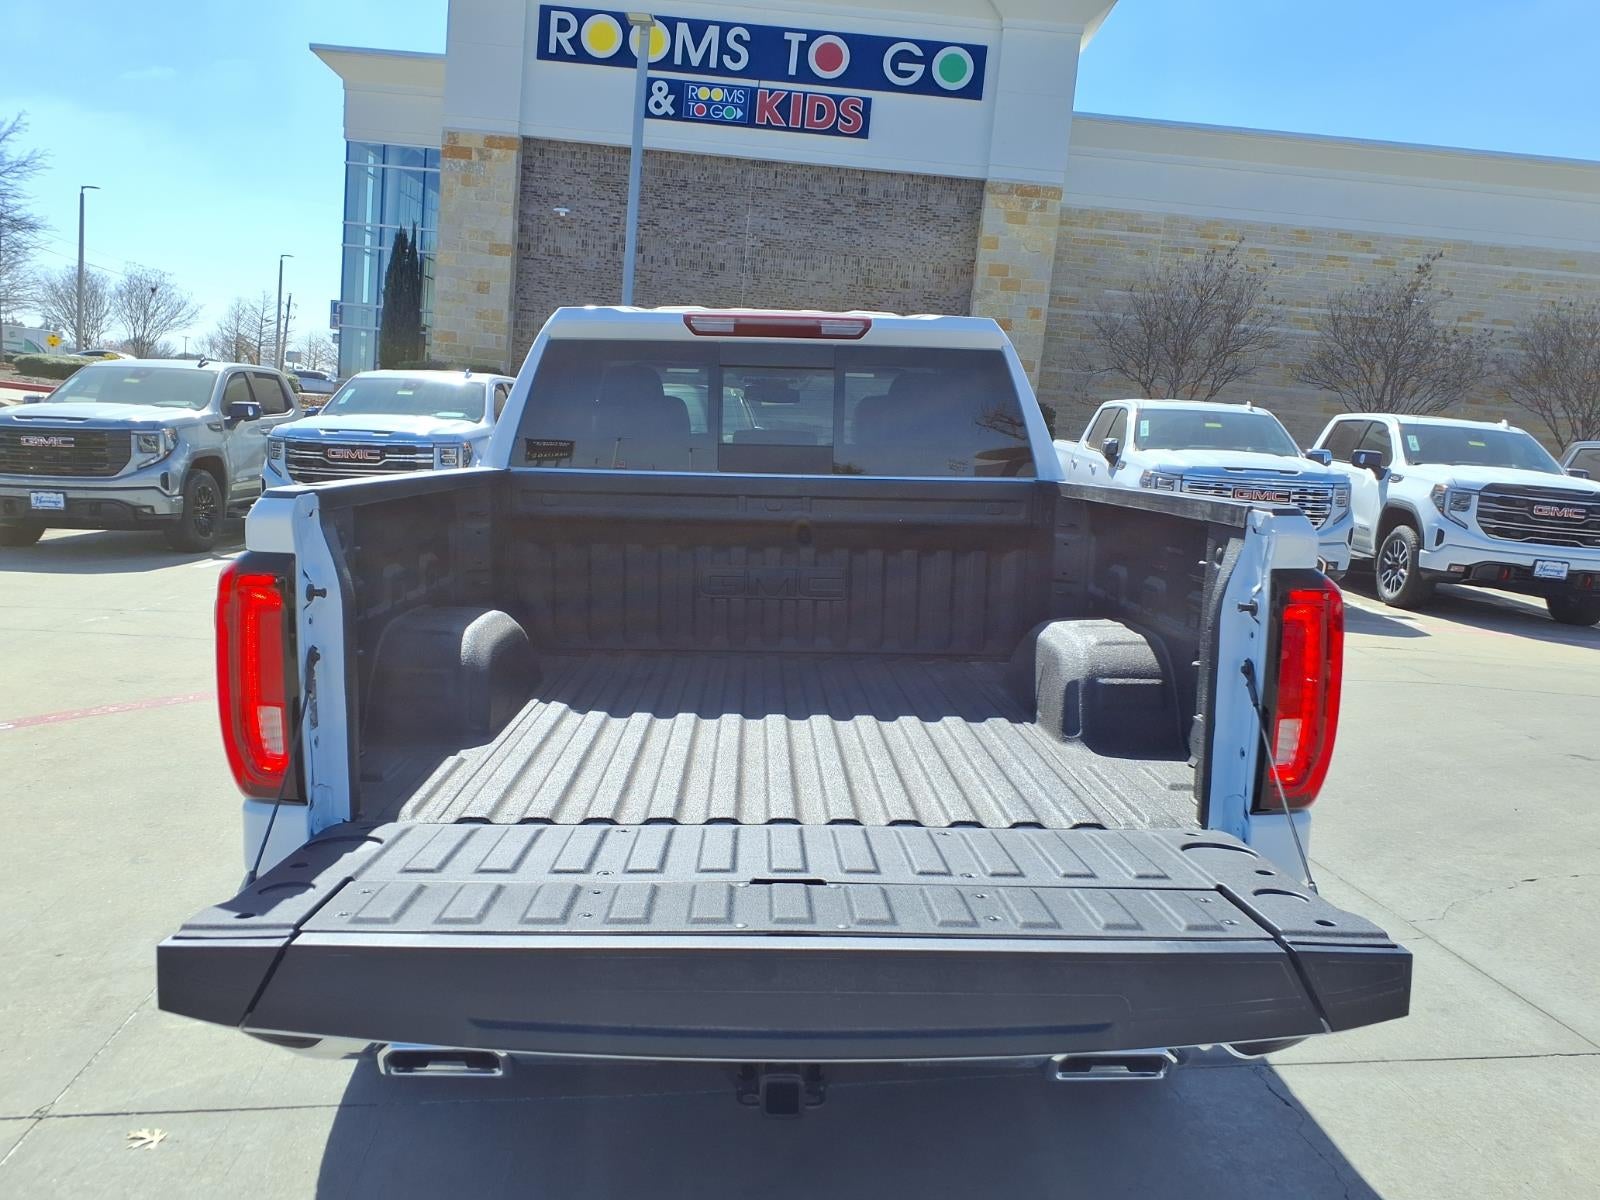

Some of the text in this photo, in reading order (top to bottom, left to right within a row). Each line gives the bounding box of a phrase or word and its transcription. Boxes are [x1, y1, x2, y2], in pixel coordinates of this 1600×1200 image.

[548, 10, 974, 91] ROOMS TO GO
[688, 85, 745, 104] ROOMS
[648, 80, 864, 135] & KIDS
[688, 102, 736, 120] TO GO
[20, 435, 75, 448] GMC
[327, 448, 381, 460] GMC
[1234, 488, 1290, 502] GMC
[1533, 504, 1586, 519] GMC
[700, 568, 846, 600] GMC
